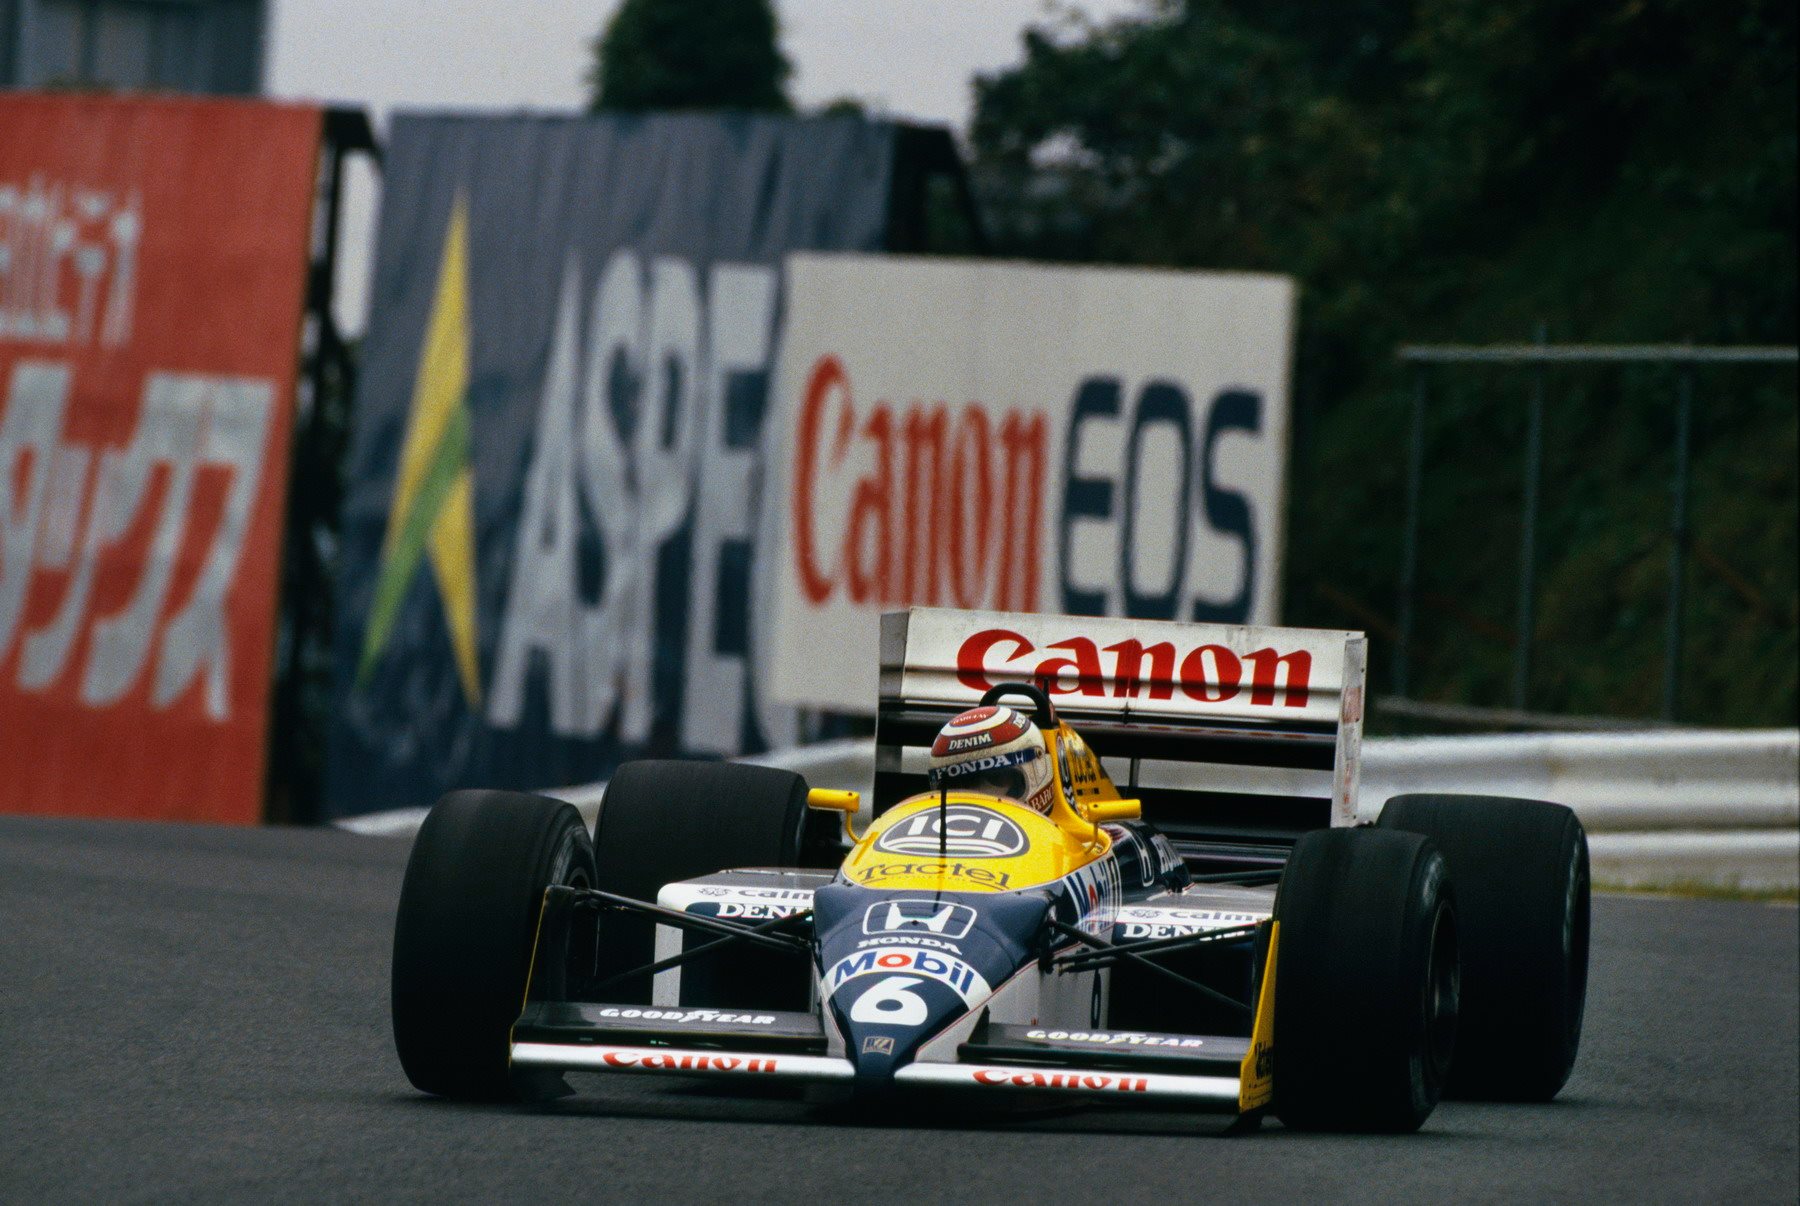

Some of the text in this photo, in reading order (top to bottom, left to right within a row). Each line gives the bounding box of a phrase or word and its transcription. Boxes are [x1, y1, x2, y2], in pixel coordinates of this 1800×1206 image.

[487, 236, 797, 757] ASPE
[791, 352, 1265, 624] Canon EOS
[957, 628, 1312, 708] Canon
[948, 732, 993, 750] DENIM
[907, 814, 1004, 840] ICI
[857, 862, 1011, 890] Tactel
[856, 935, 963, 956] HONDA
[833, 951, 976, 996] Mobil
[850, 976, 929, 1026] 6
[599, 1007, 776, 1025] GOODYEAR
[1026, 1029, 1204, 1048] GOODYEAR
[602, 1051, 778, 1075] Canon
[973, 1068, 1149, 1092] Canon
